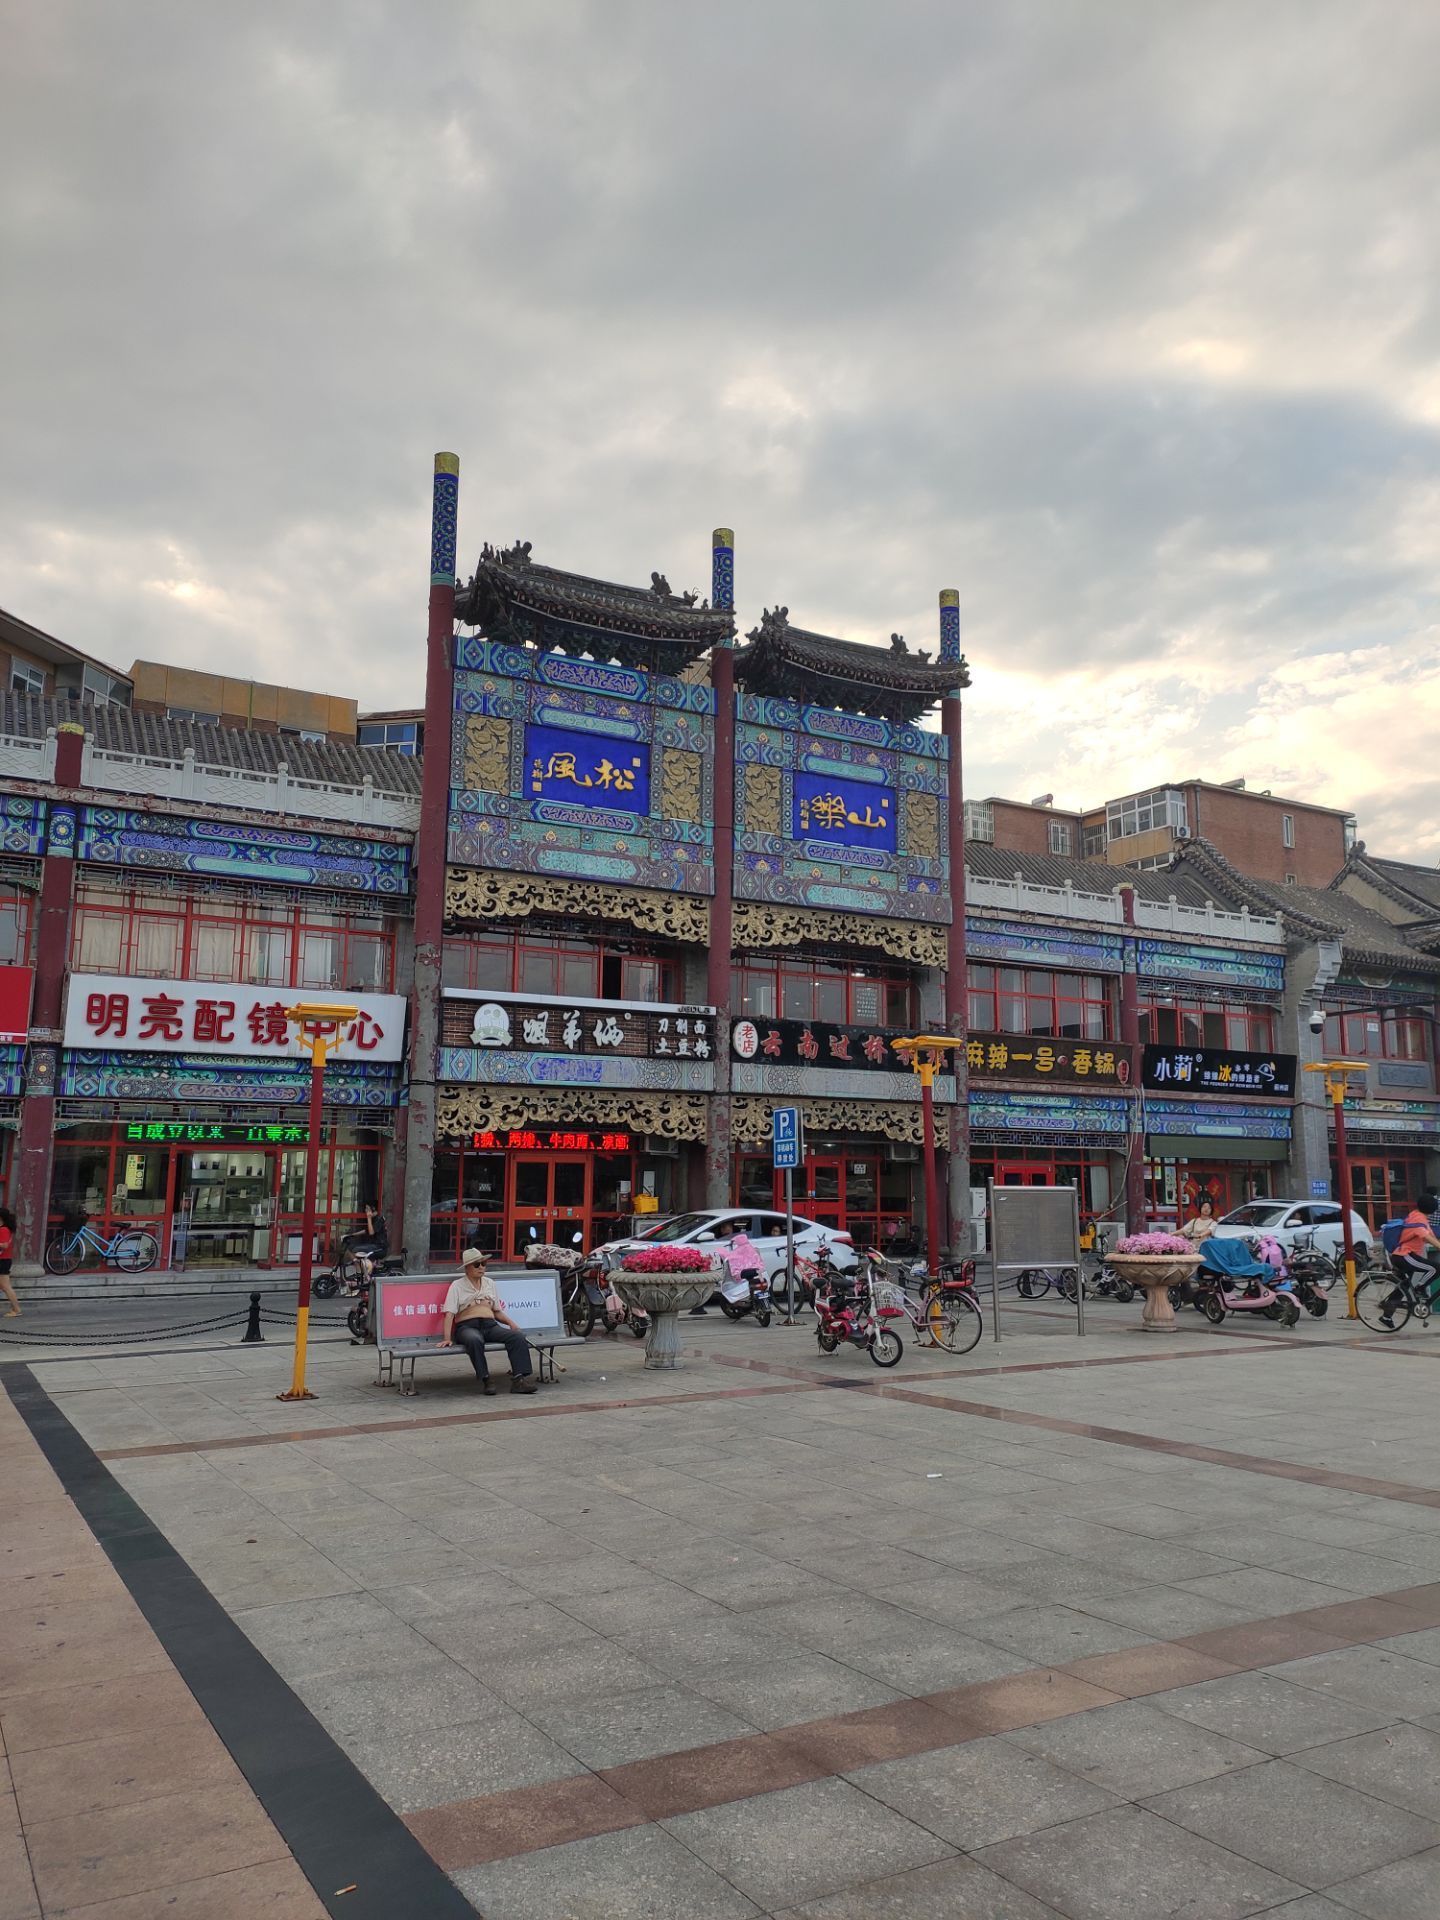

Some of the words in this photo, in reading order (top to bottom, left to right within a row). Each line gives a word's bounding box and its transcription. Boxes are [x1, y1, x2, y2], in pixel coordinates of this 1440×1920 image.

[658, 1018, 706, 1035] 刀削面
[655, 1037, 711, 1058] 土豆粉
[742, 1024, 754, 1053] 老店
[780, 1112, 790, 1138] P
[508, 1301, 541, 1309] HUAWEI
